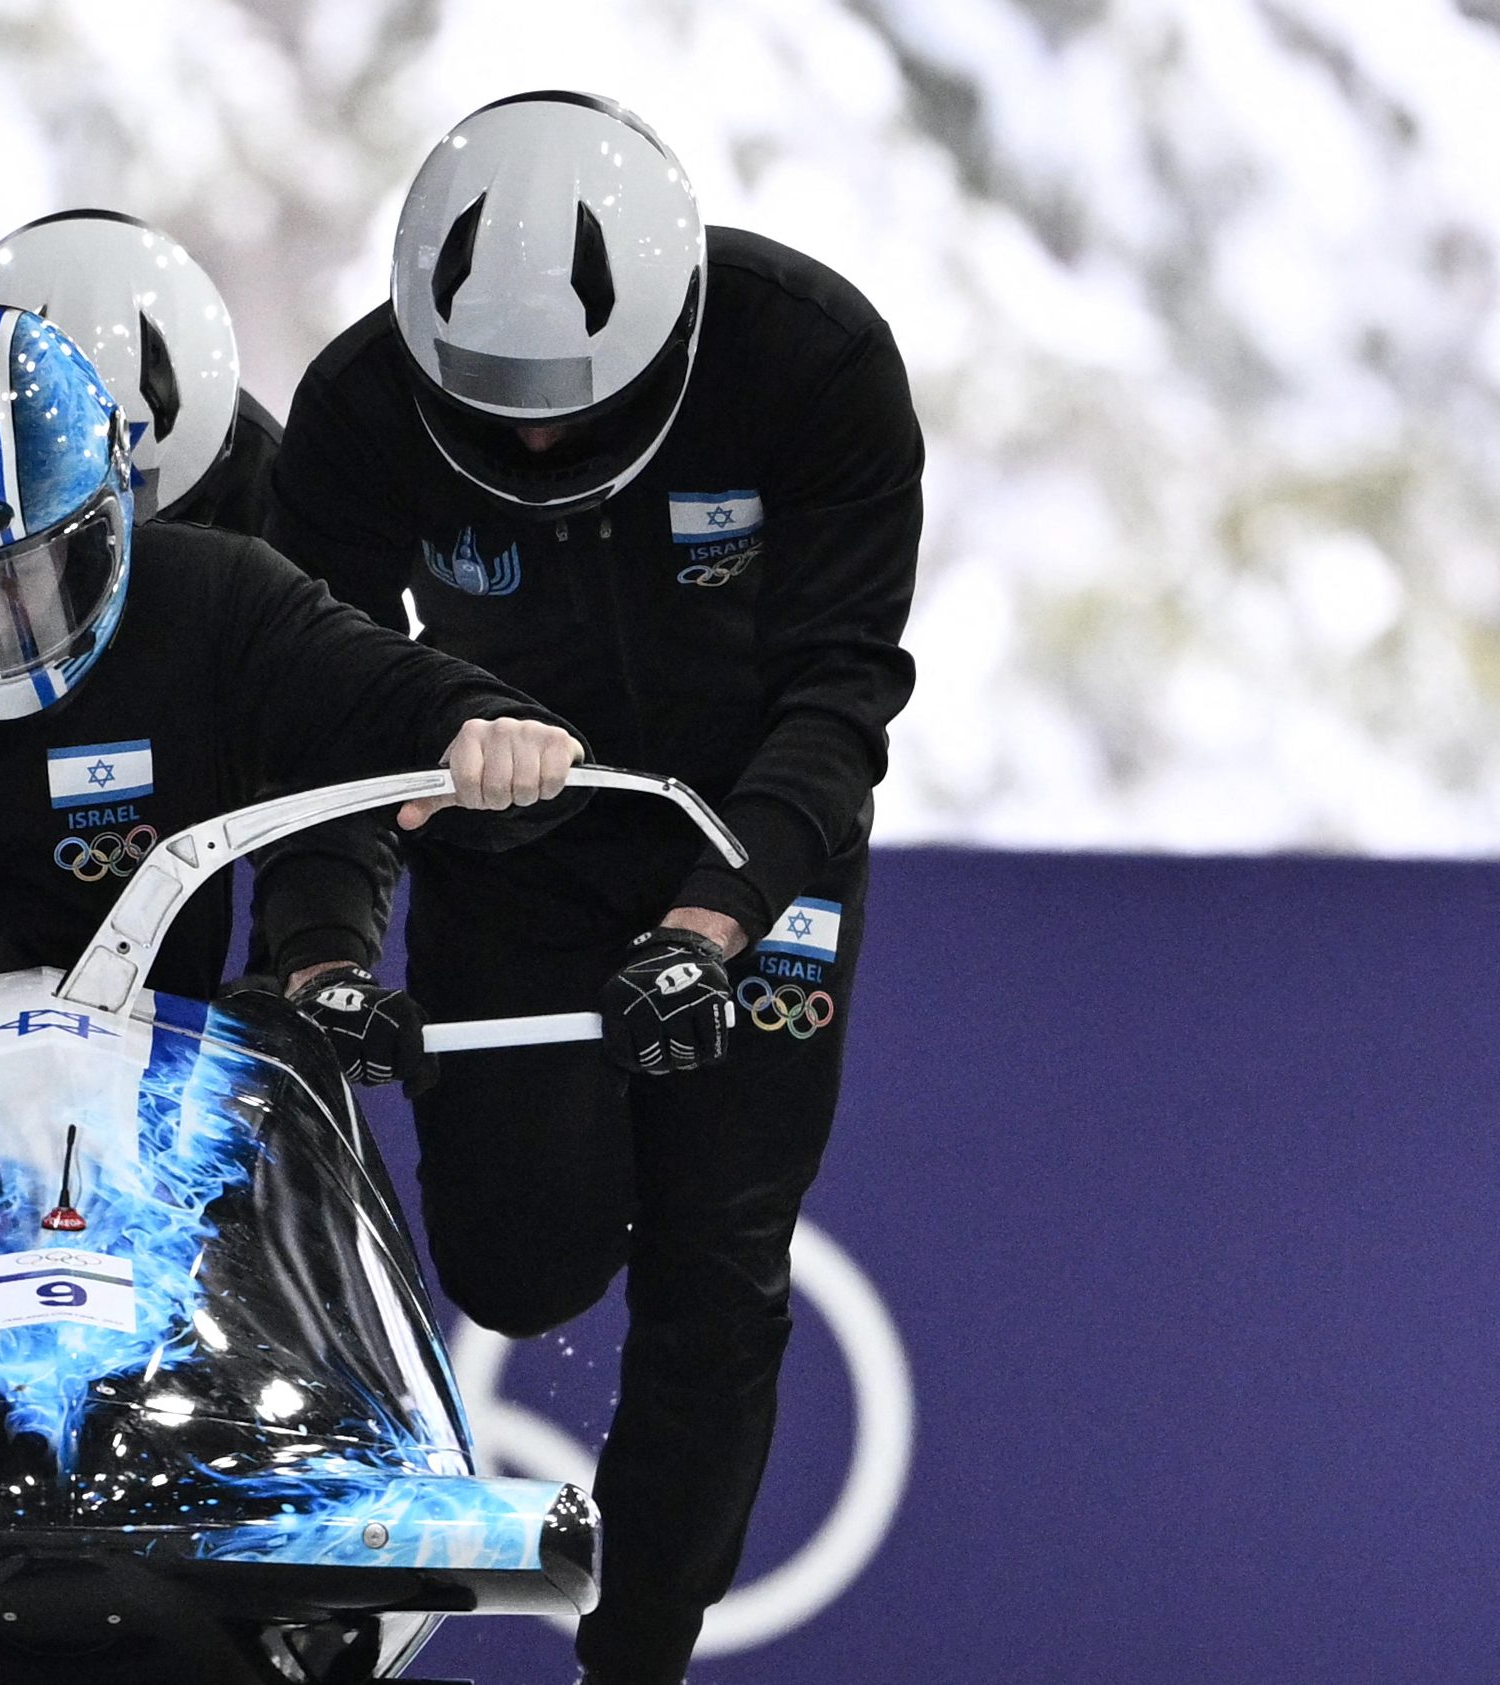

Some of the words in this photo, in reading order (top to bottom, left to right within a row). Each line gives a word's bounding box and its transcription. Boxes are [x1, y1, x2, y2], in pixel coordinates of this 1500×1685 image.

[67, 804, 140, 830] ISRAEL
[759, 955, 822, 984] ISRAEL
[36, 1281, 87, 1307] 9
